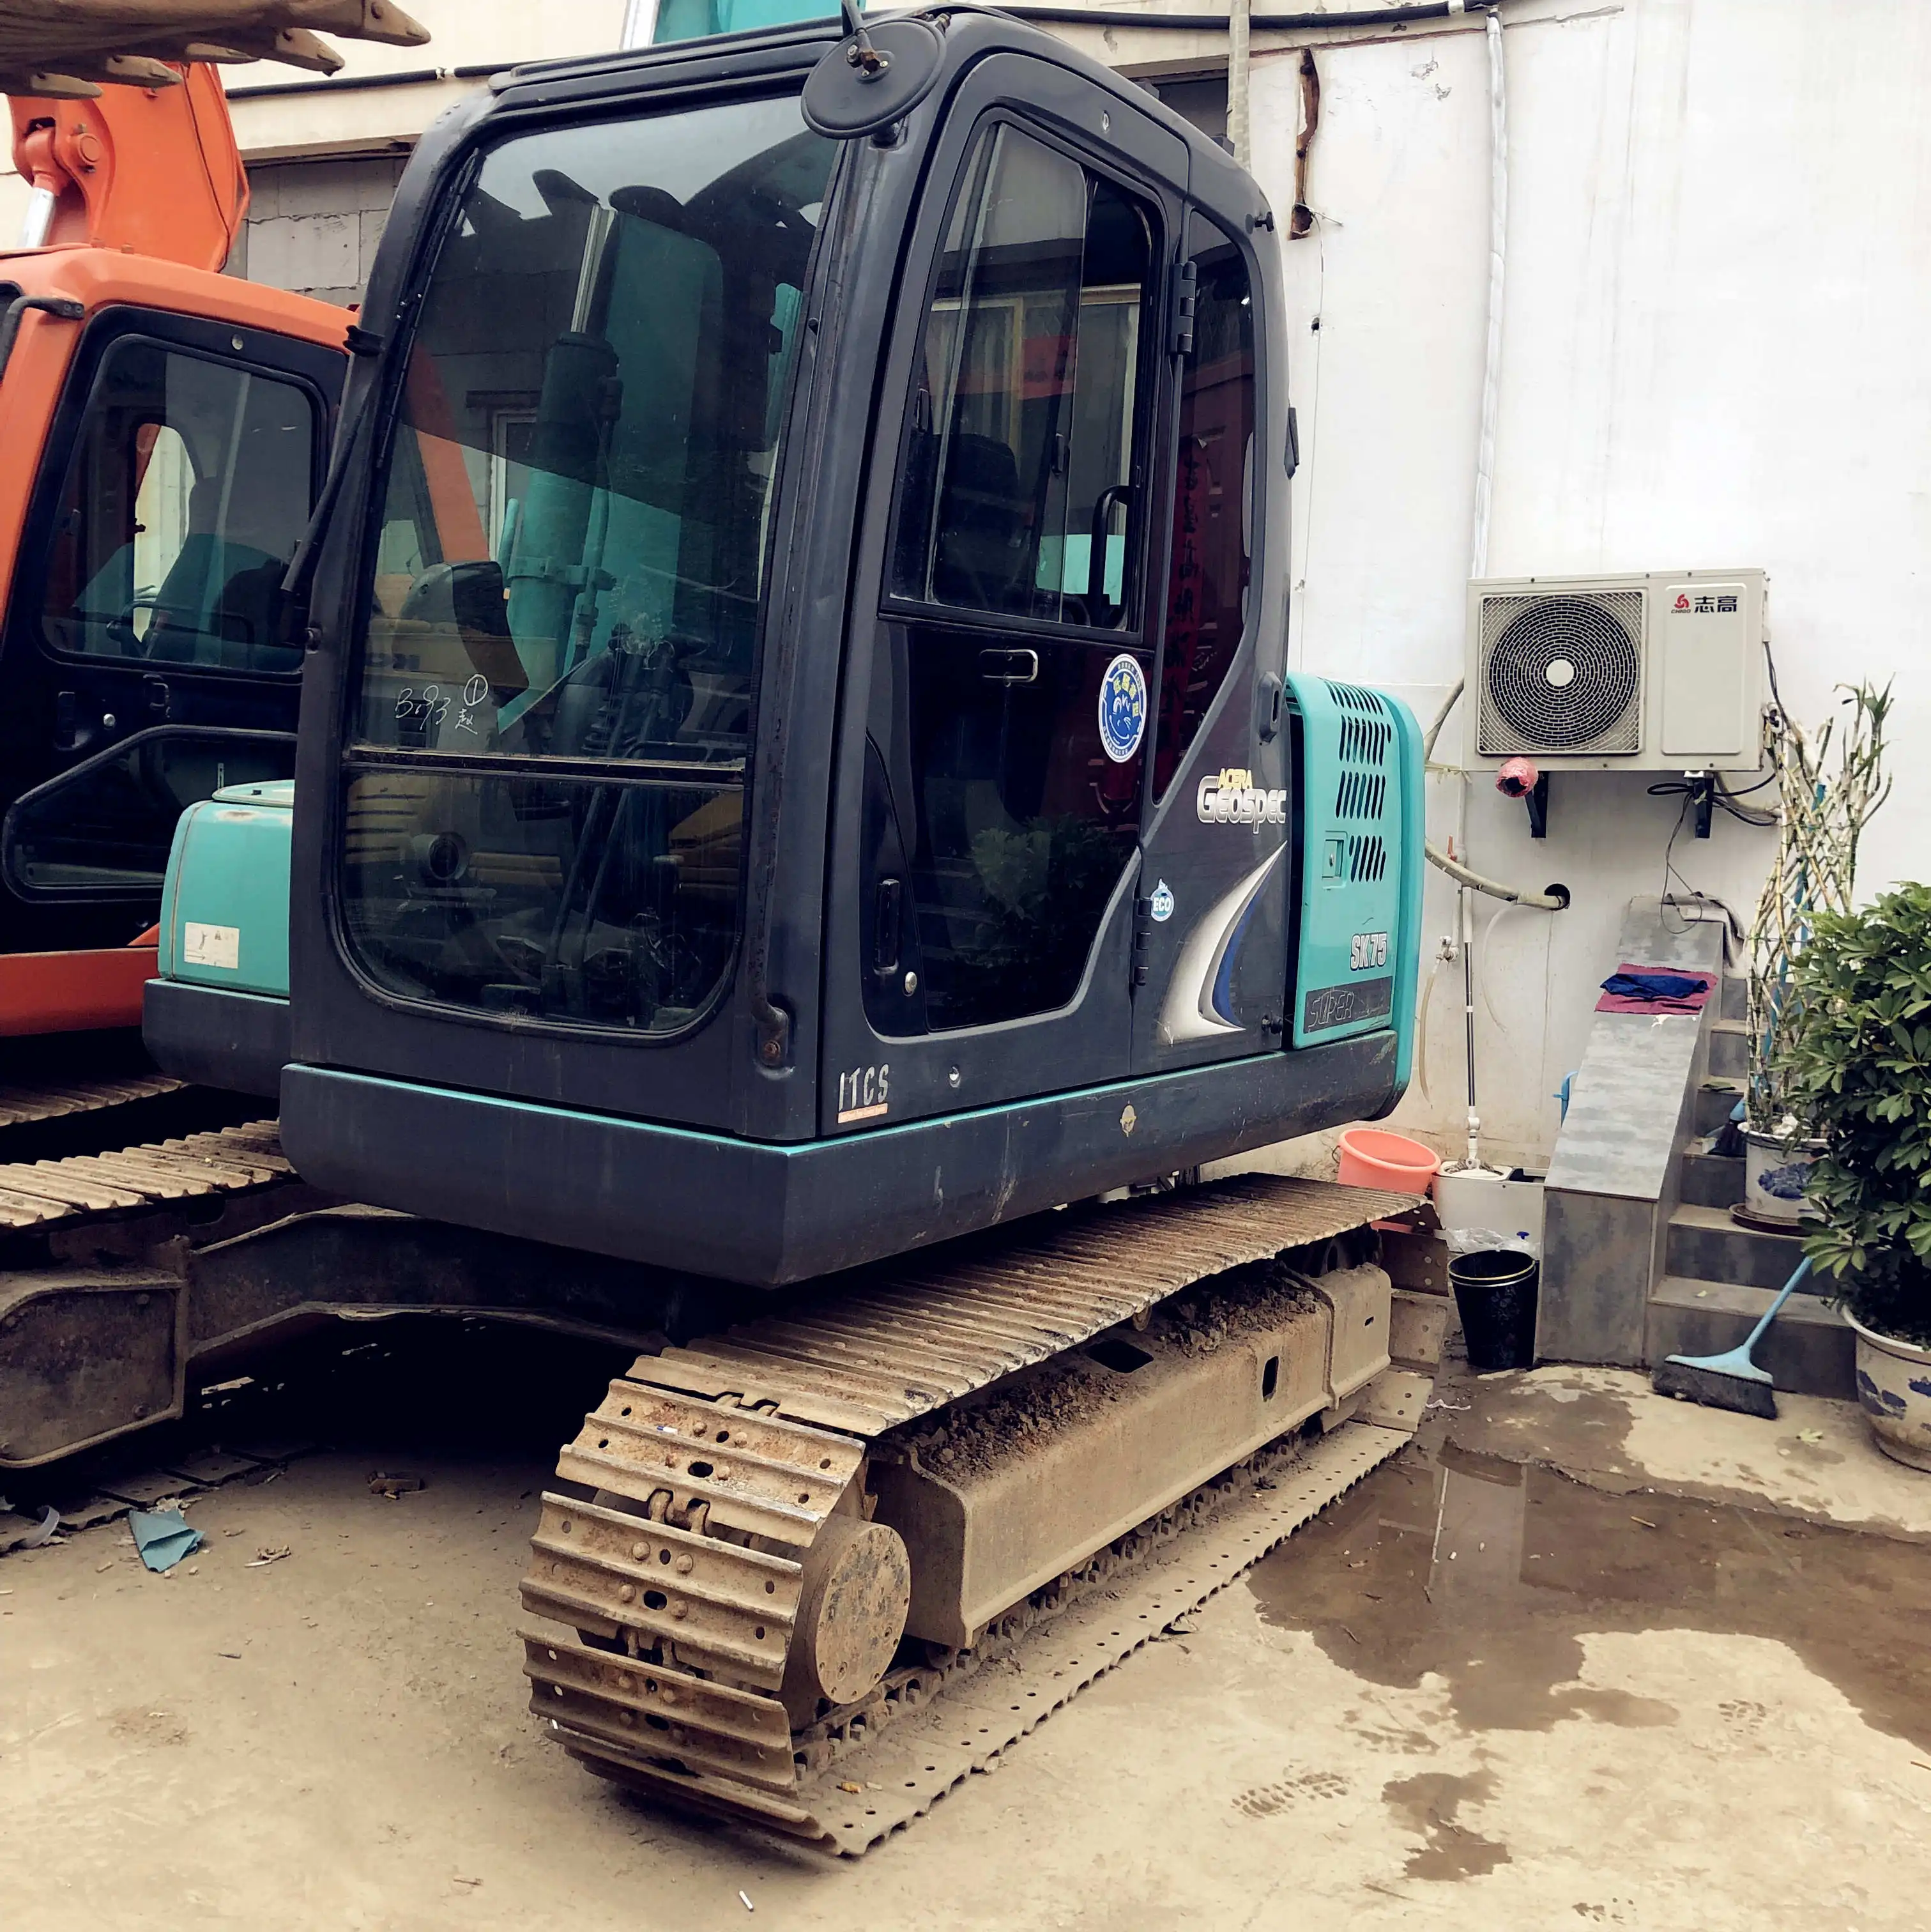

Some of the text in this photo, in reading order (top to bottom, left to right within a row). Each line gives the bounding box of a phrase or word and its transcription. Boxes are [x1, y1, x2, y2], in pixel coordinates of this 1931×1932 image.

[1694, 595, 1737, 613] 志高
[1152, 896, 1171, 912] ECO
[1350, 932, 1387, 971] SK75
[838, 1064, 889, 1112] ITCS
